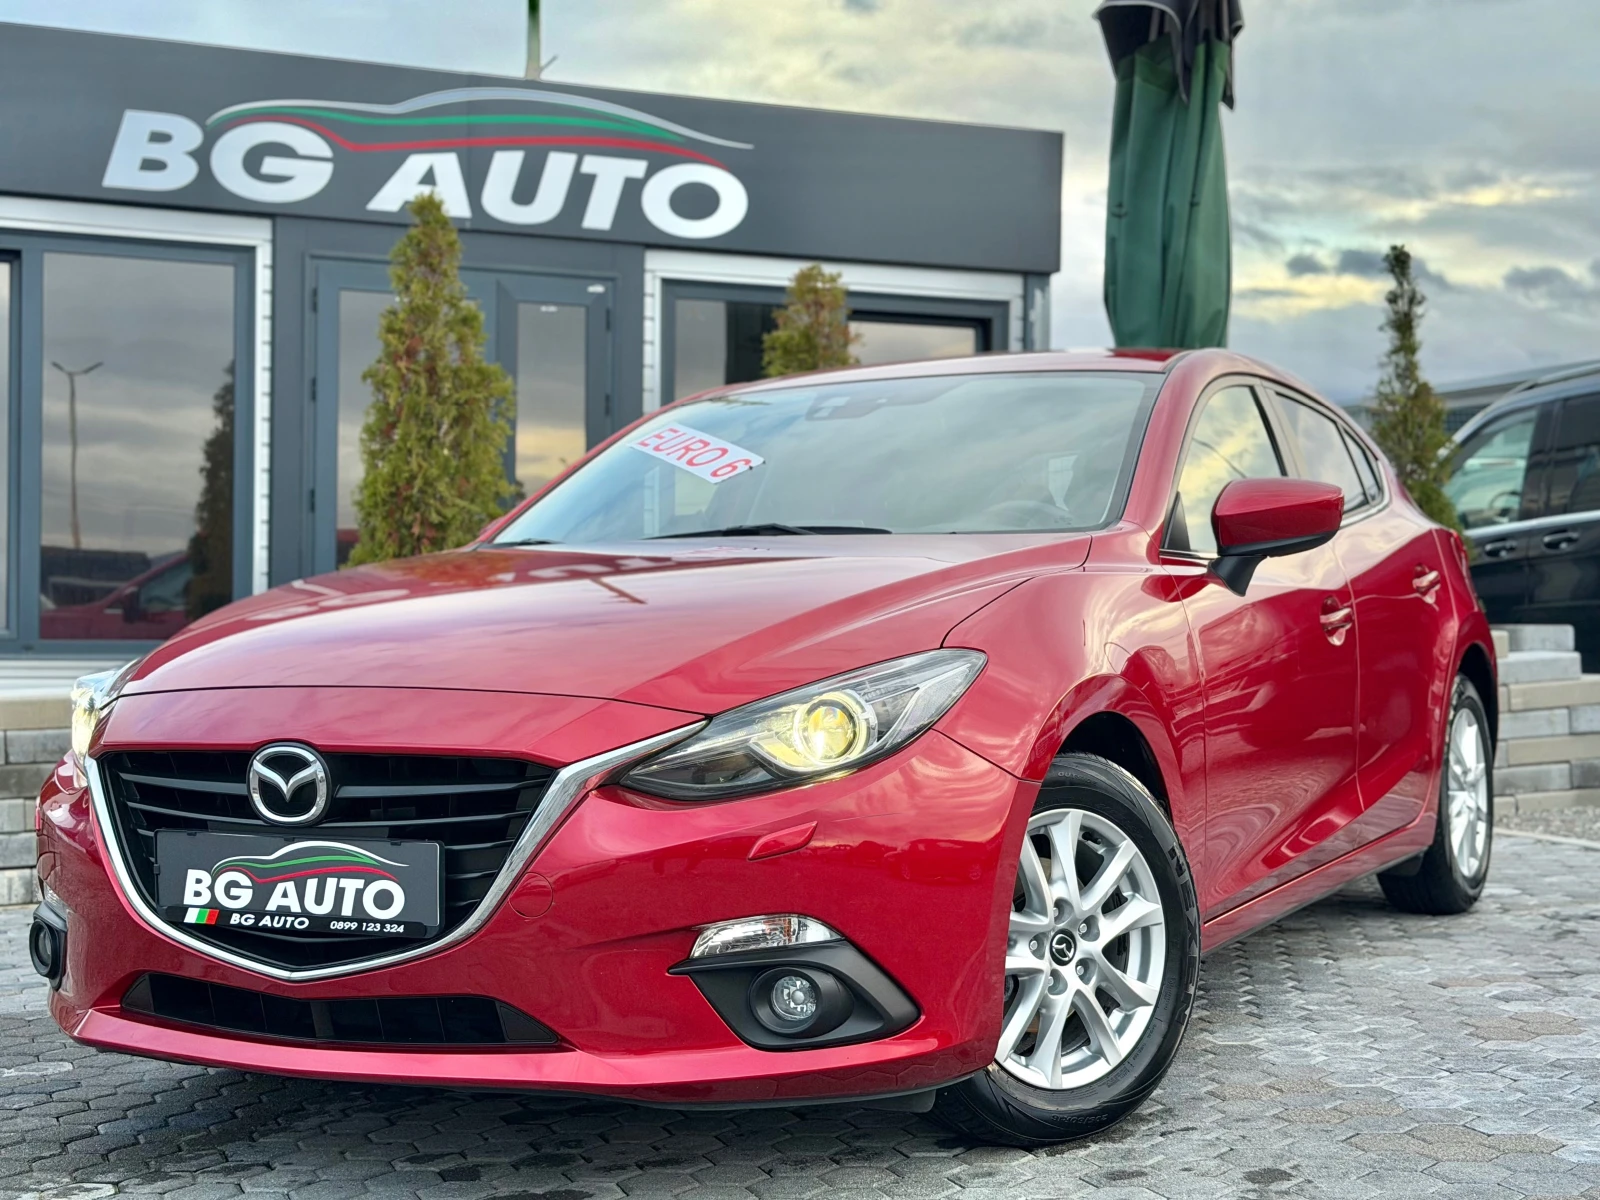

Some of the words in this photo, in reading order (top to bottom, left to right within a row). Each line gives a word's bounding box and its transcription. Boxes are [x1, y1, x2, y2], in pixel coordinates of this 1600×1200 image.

[102, 109, 334, 203] BG
[366, 150, 748, 239] AUTO
[637, 428, 729, 467] EURO
[710, 458, 752, 478] 6
[183, 869, 253, 909] BG
[265, 877, 405, 919] AUTO
[229, 913, 255, 925] BG
[258, 916, 310, 929] AUTO
[330, 921, 358, 930] 0899
[362, 923, 381, 931] 123
[383, 924, 404, 933] 324
[1168, 842, 1198, 1025] NEXEN
